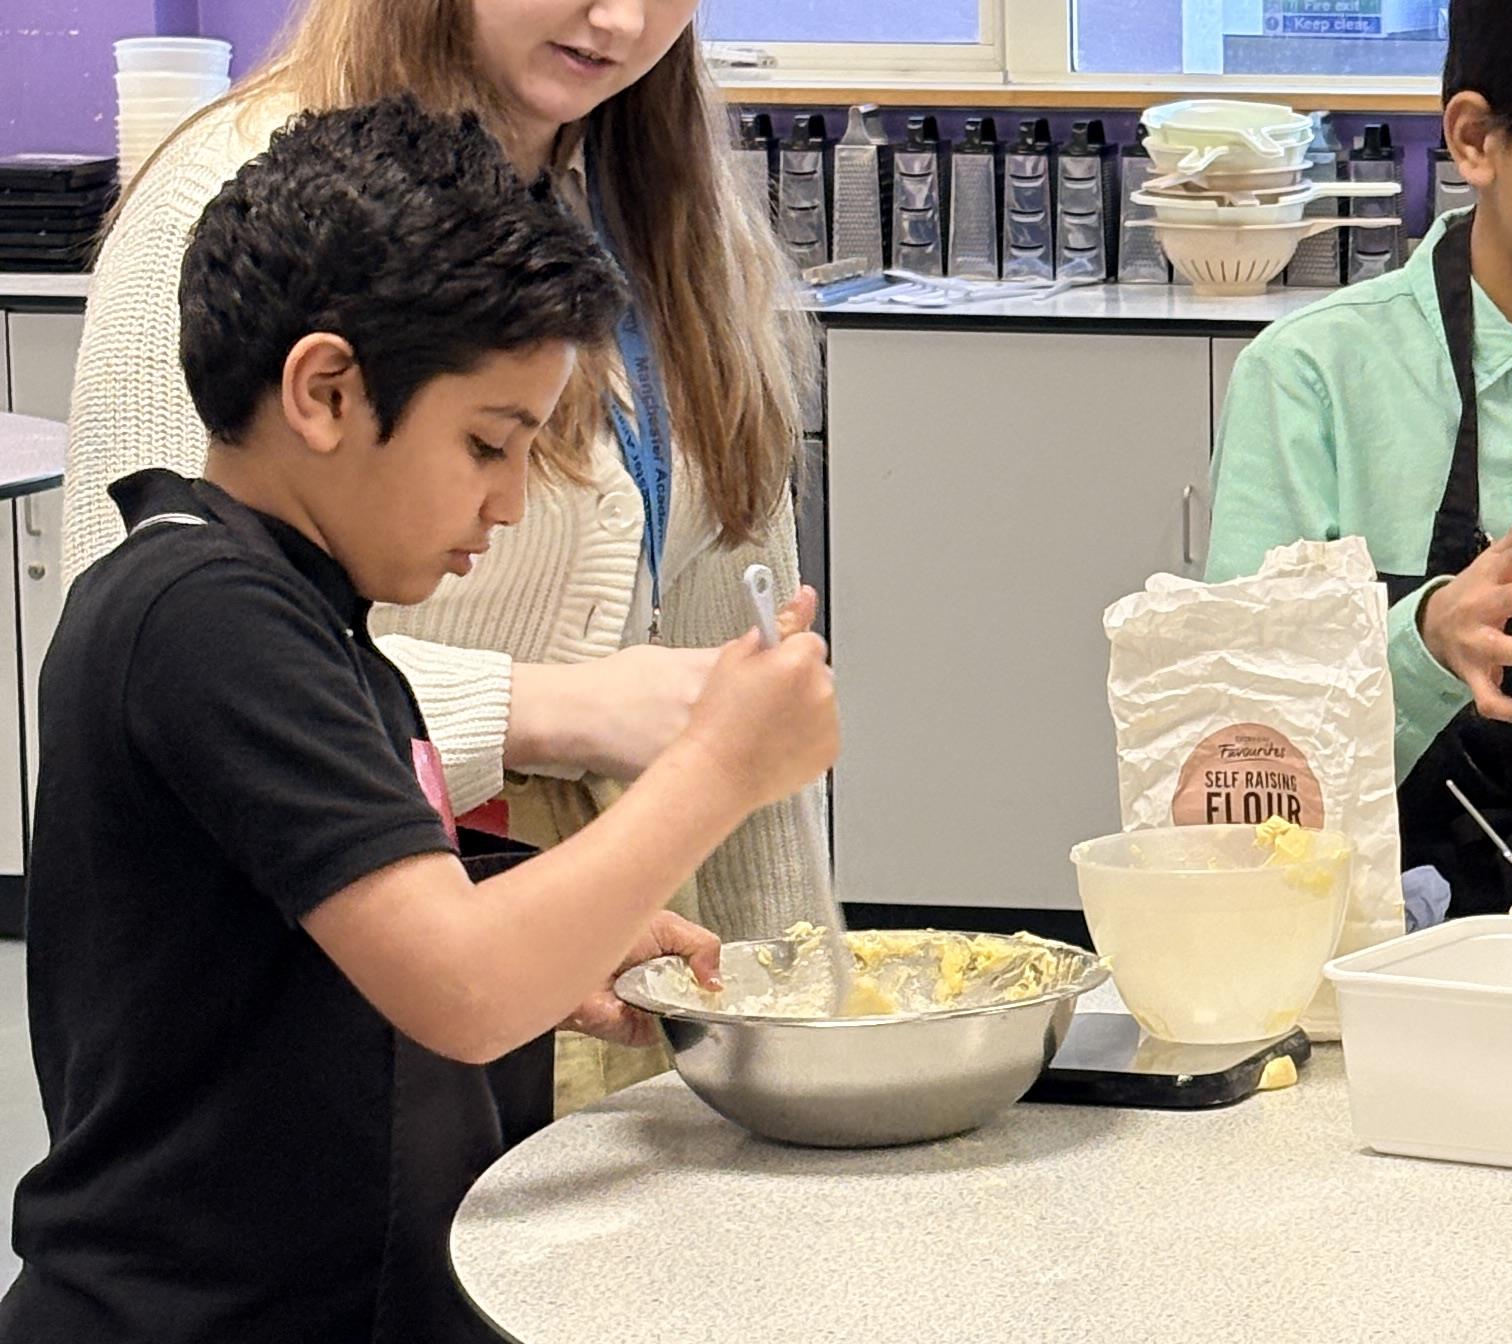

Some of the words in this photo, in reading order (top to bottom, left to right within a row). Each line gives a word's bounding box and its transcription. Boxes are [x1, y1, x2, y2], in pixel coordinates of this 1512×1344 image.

[1304, 0, 1330, 11] Fire
[1335, 0, 1360, 12] exit
[1295, 17, 1331, 33] Keep
[1333, 17, 1369, 32] clear
[1218, 742, 1286, 759] Favourites
[1205, 770, 1240, 789] SELF
[1245, 771, 1298, 792] RAISING
[1206, 792, 1302, 826] FLOUR
